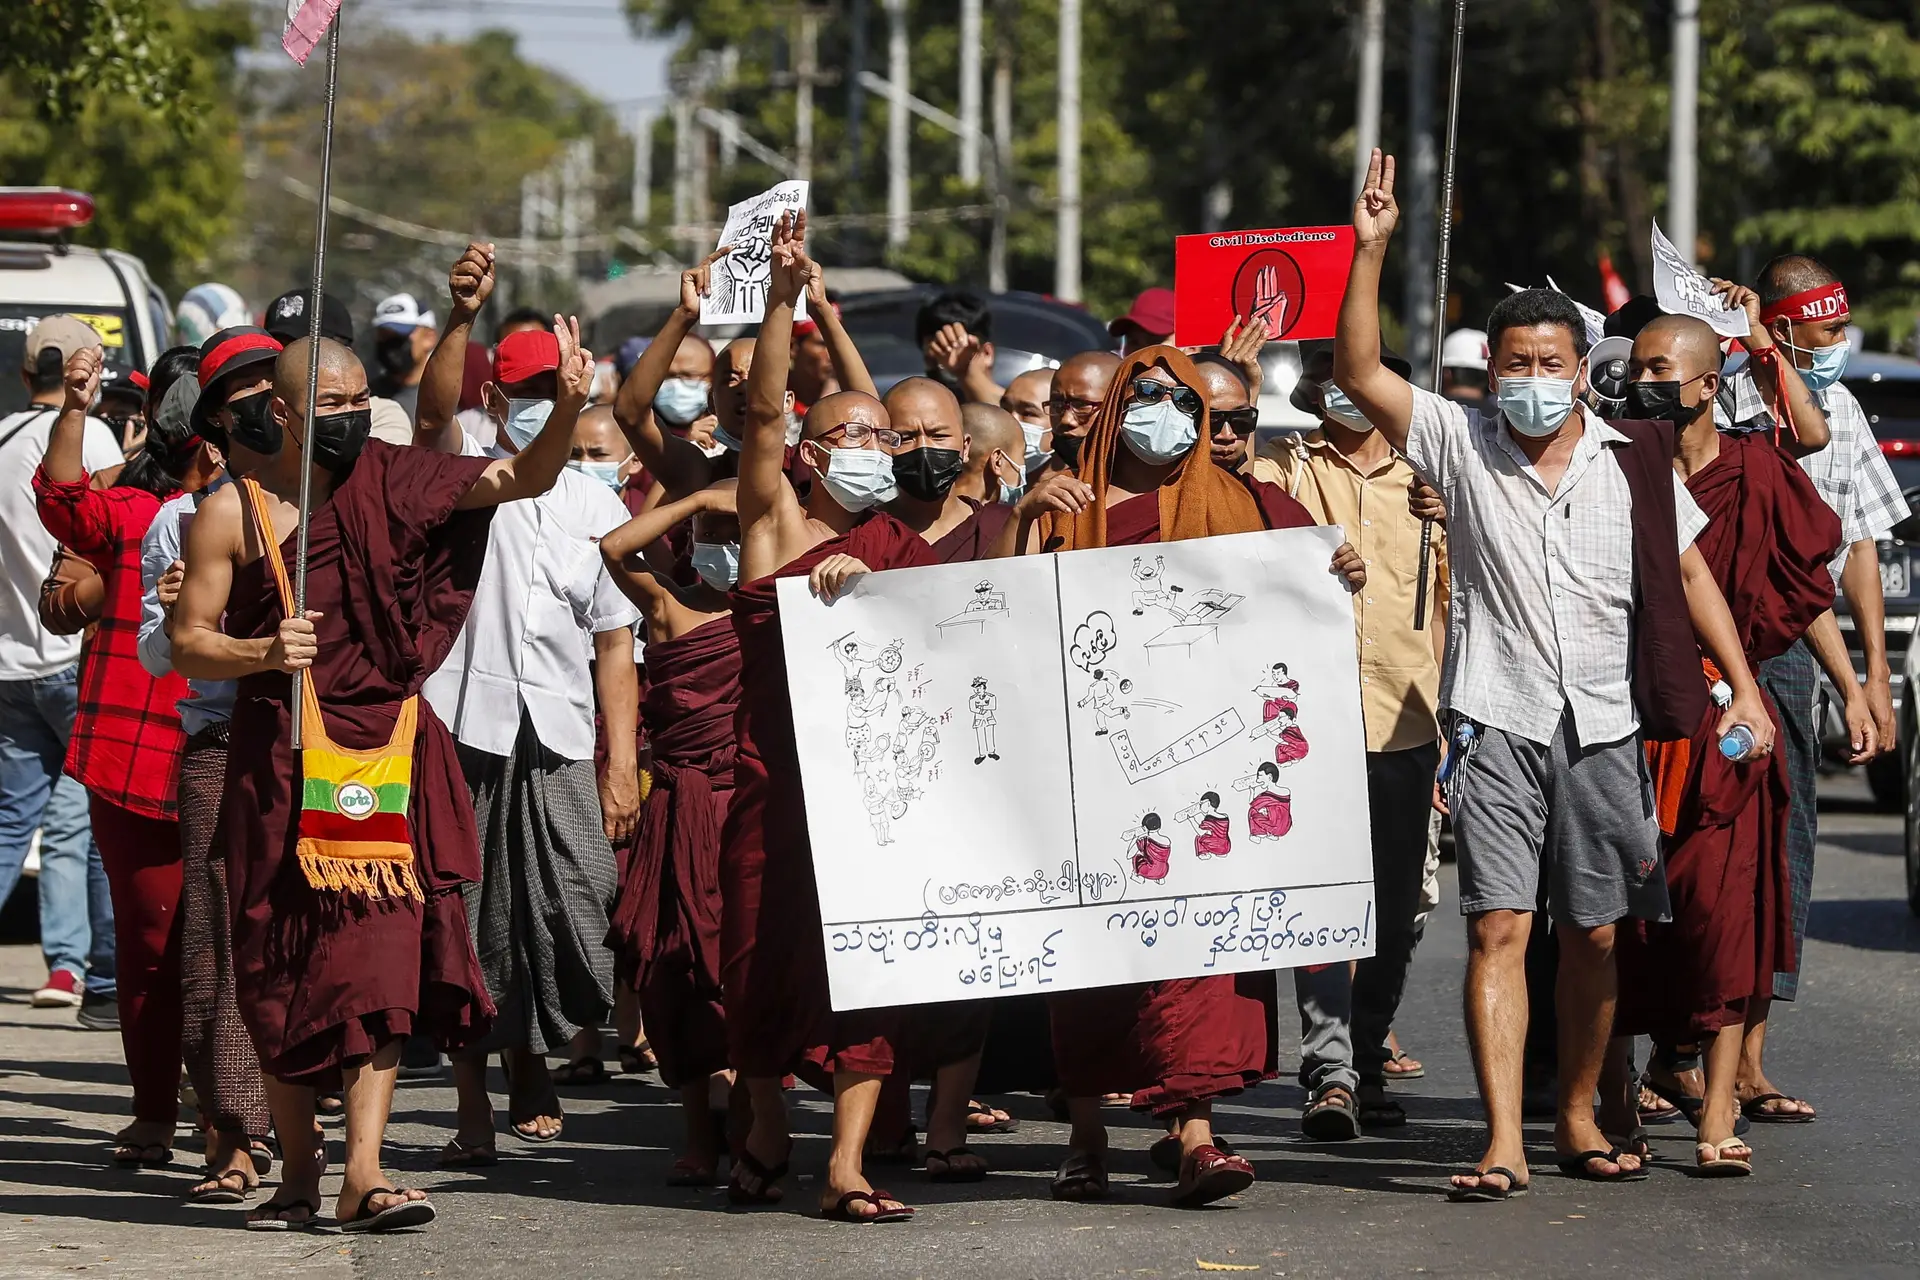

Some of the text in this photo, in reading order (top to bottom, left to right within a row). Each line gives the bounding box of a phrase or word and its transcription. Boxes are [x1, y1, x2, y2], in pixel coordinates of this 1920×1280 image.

[1210, 231, 1336, 247] Civil Disobedience
[1801, 296, 1838, 318] NLD
